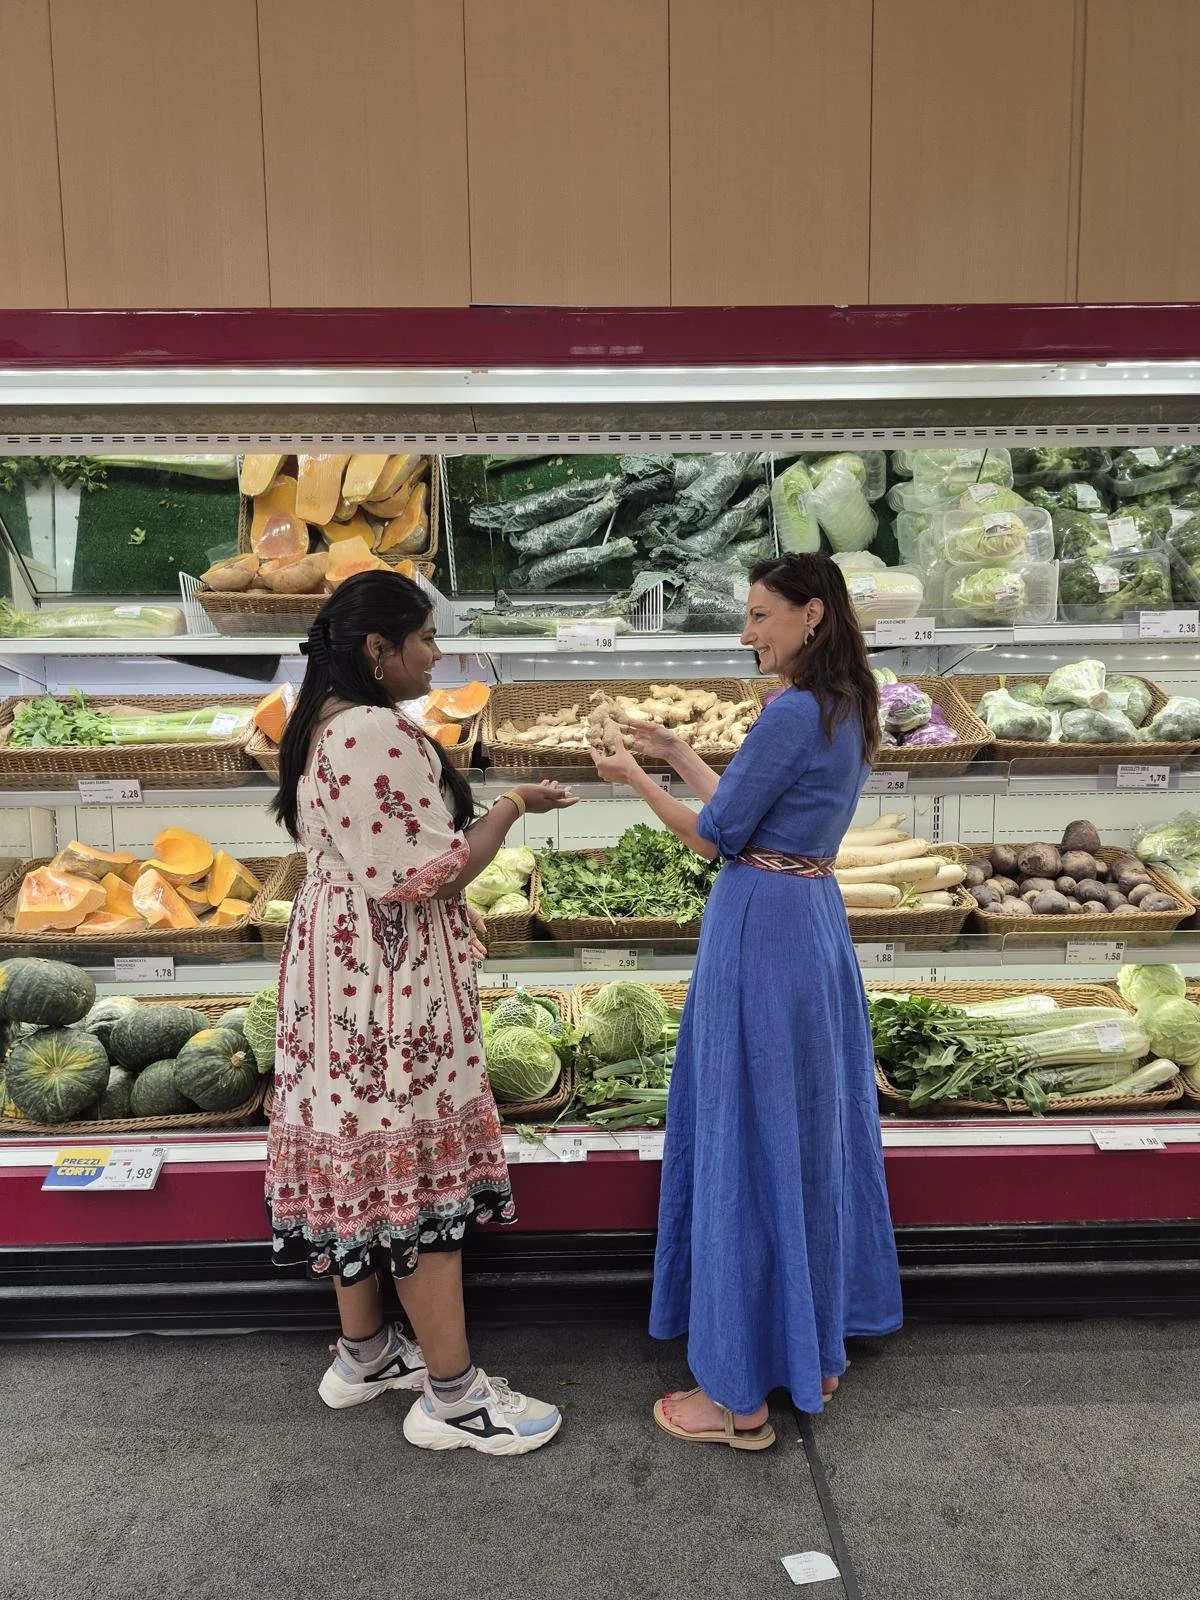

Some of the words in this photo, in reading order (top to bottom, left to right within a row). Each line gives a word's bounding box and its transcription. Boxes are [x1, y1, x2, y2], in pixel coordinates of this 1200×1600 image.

[1179, 623, 1196, 634] 2,38
[915, 630, 932, 640] 2,18
[595, 638, 612, 648] 1,98
[1150, 774, 1166, 783] 1,78
[887, 781, 904, 790] 2,58
[121, 790, 139, 799] 2,28
[876, 953, 892, 963] 1,88
[1104, 952, 1121, 961] 1,58
[619, 959, 636, 968] 2,98
[155, 968, 172, 978] 1,78
[56, 1166, 97, 1176] CORTI
[126, 1167, 153, 1180] 1,98
